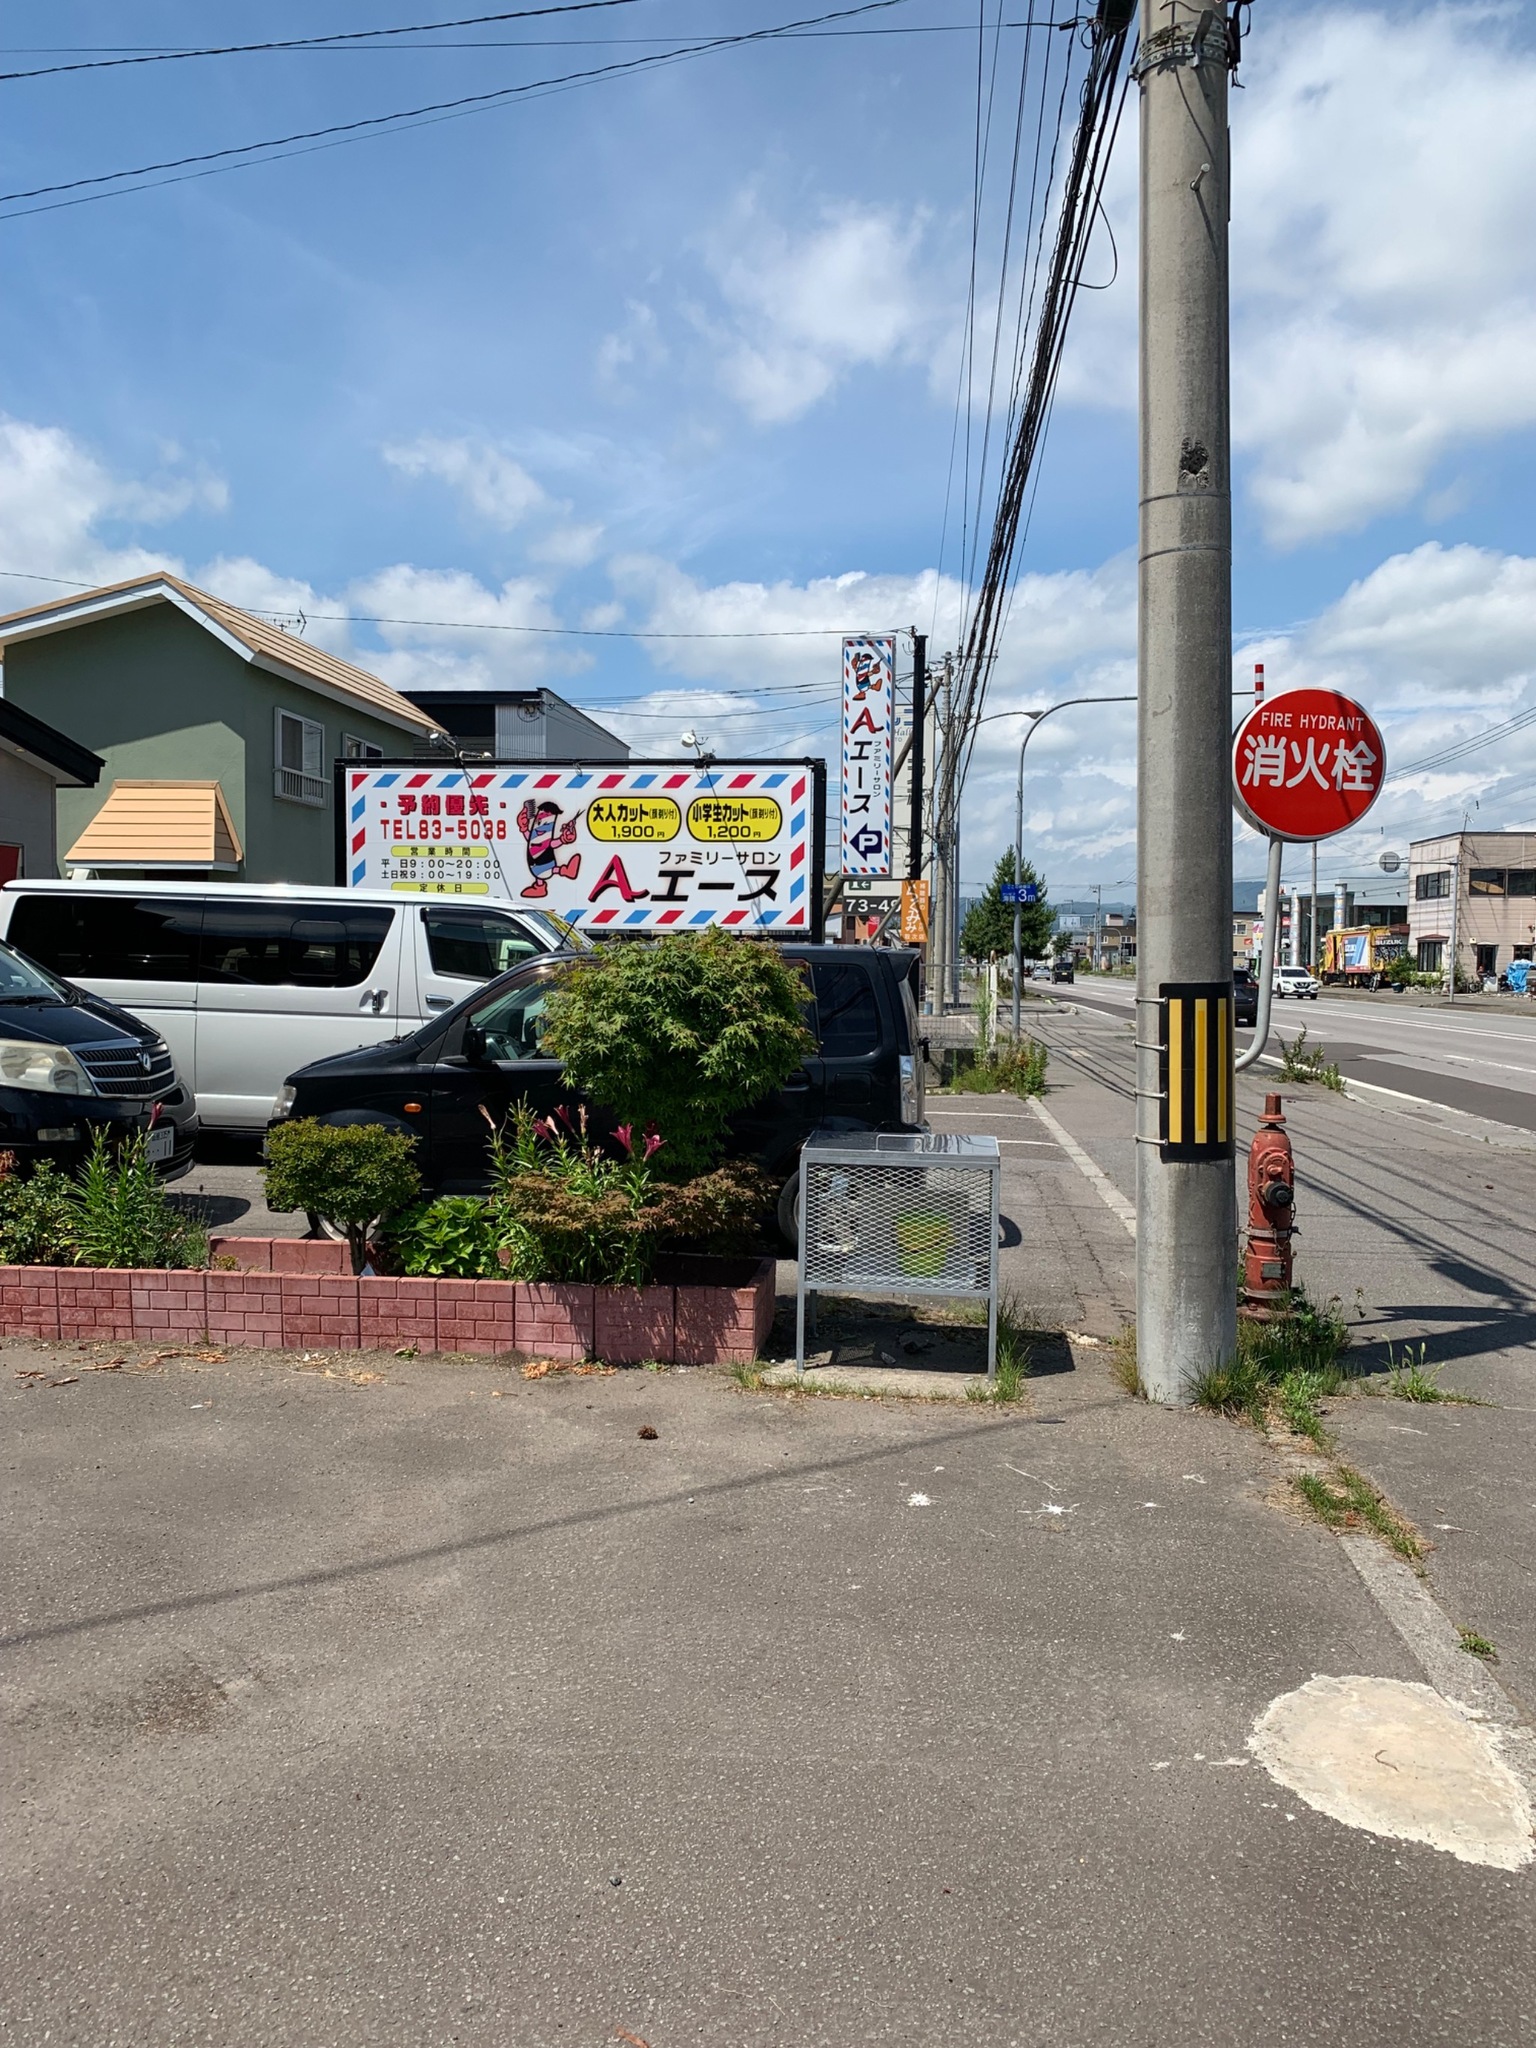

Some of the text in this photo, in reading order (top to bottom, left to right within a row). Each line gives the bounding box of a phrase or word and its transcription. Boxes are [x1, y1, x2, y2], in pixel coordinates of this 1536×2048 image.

[1261, 712, 1364, 732] FIRE HYDRANT
[873, 741, 882, 798] ファミリーサロン
[1242, 734, 1377, 791] 消火栓
[859, 834, 879, 851] P
[410, 847, 471, 856] 営業時間
[659, 851, 781, 865] ファミリーサロン
[419, 883, 462, 893] 定休日
